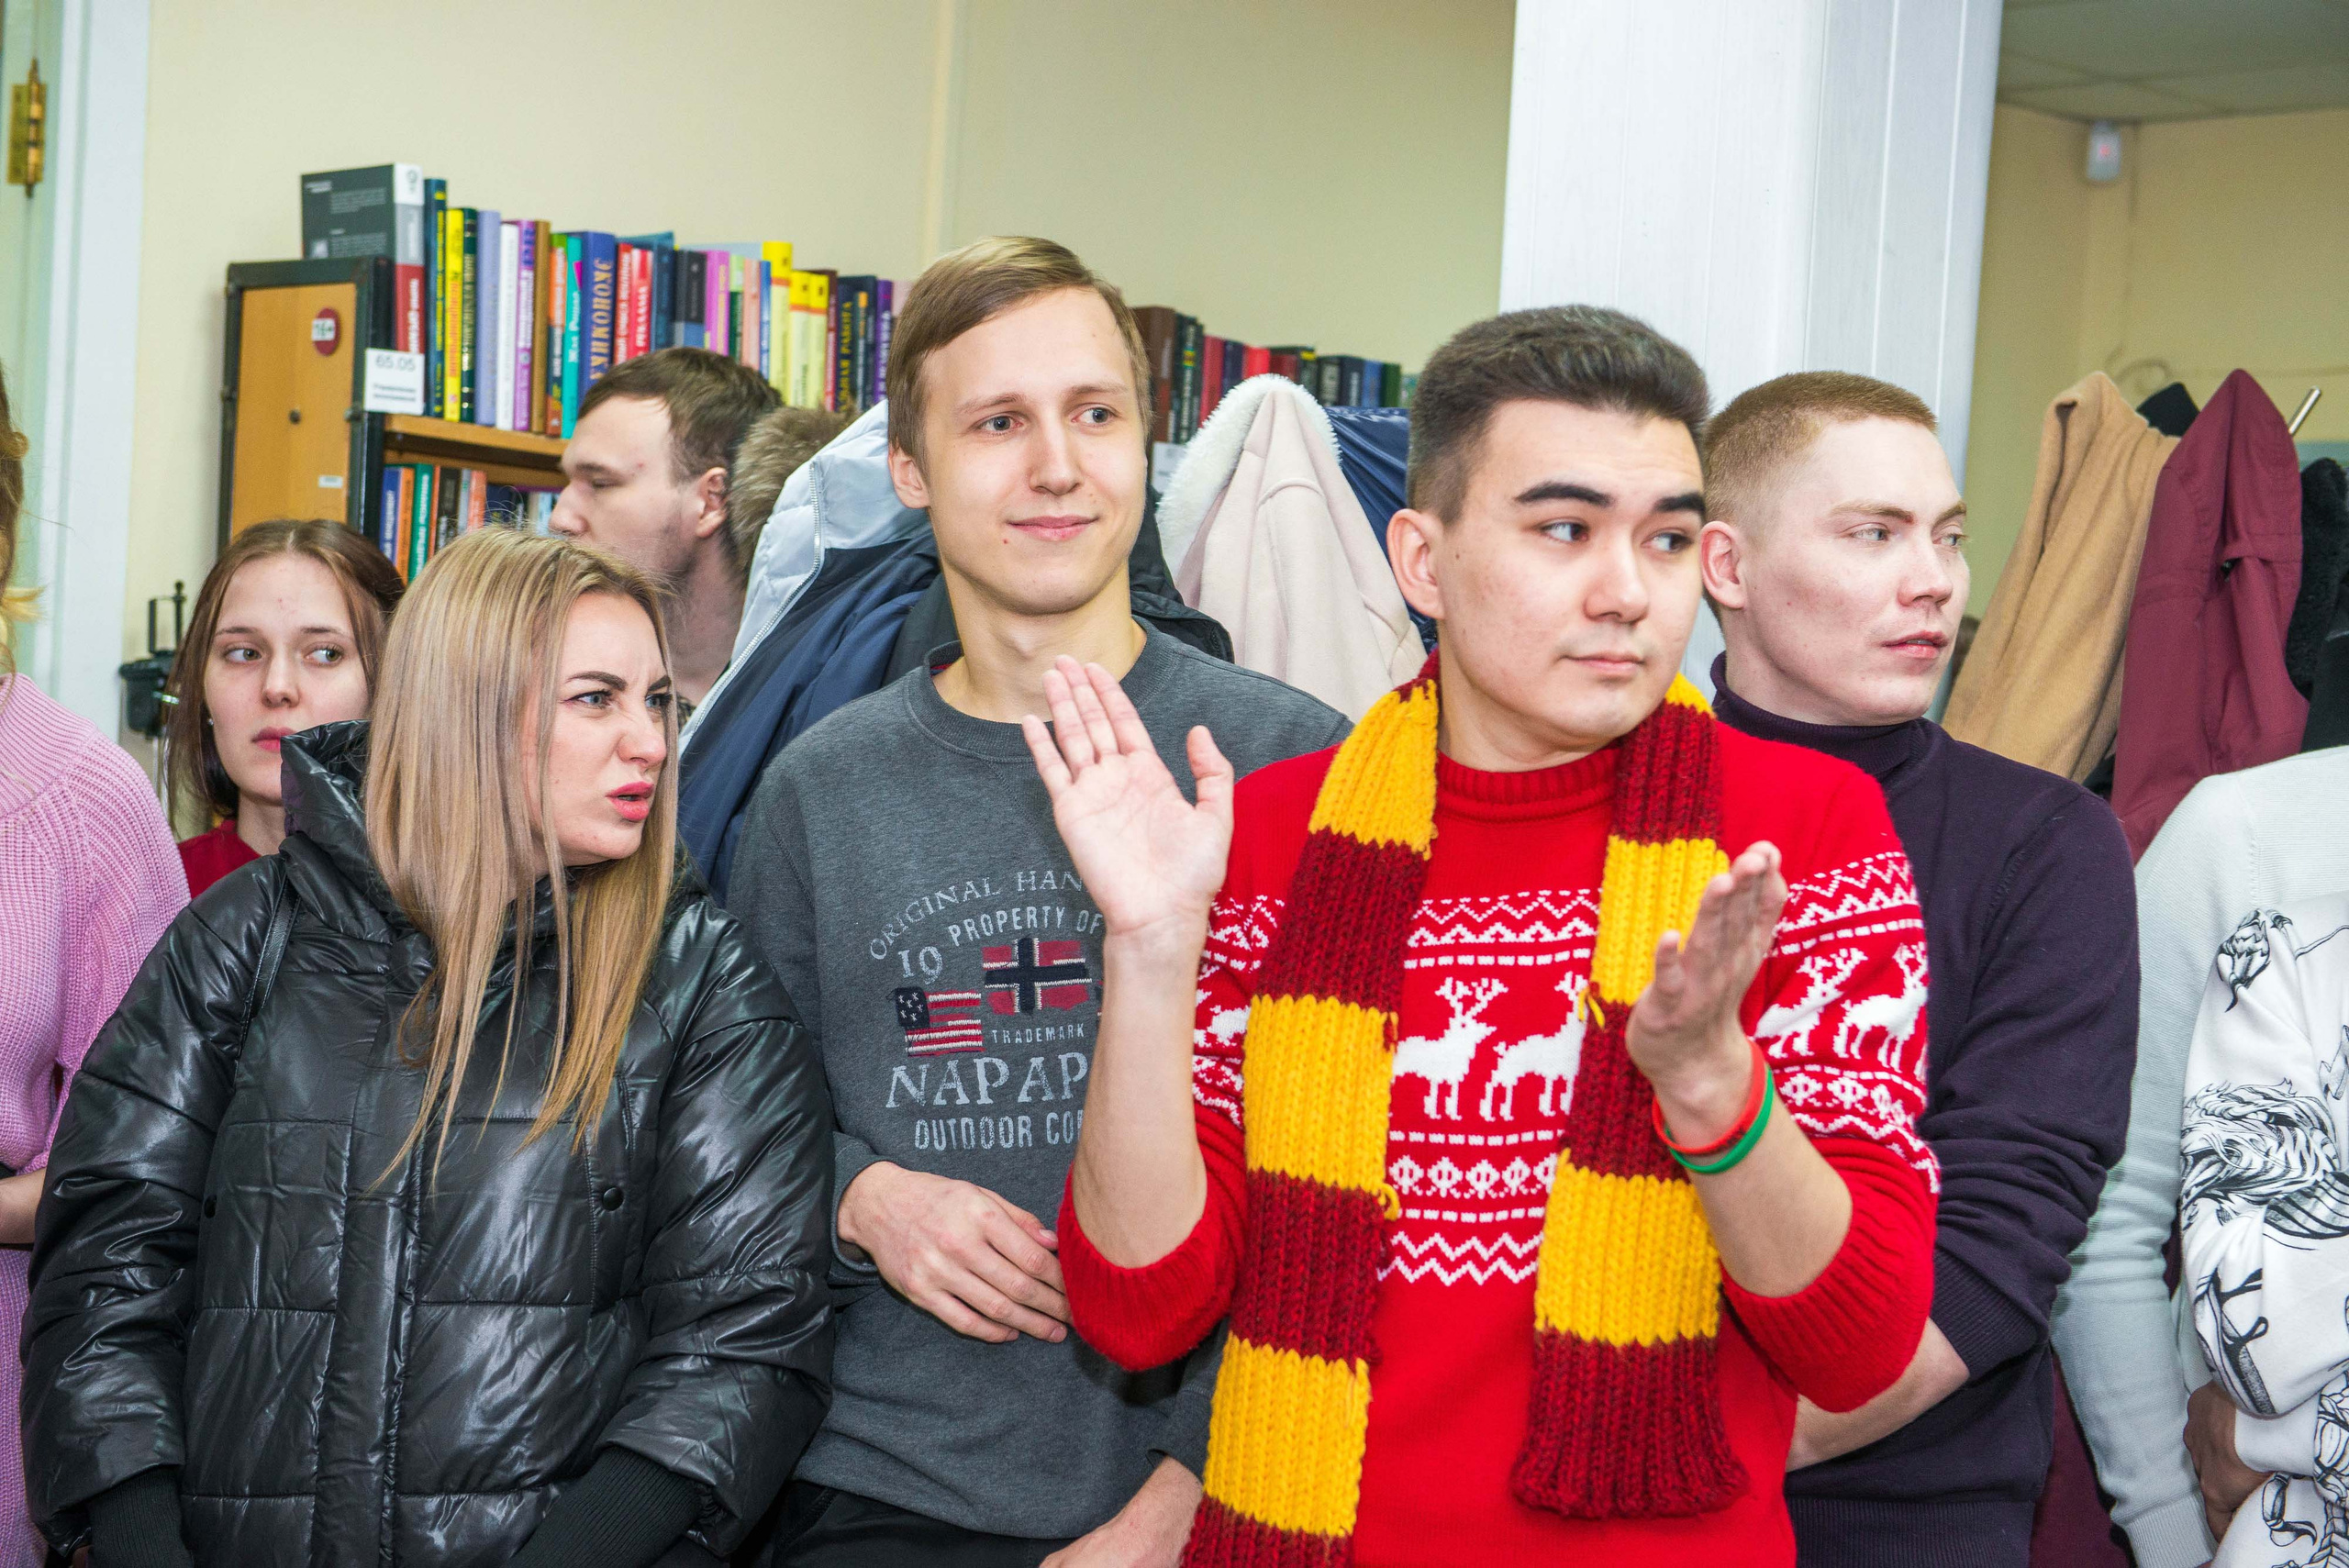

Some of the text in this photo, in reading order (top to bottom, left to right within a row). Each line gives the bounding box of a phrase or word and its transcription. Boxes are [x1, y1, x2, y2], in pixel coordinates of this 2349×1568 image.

[375, 354, 416, 373] 65.05
[869, 876, 1002, 961] ORIGINAL
[948, 905, 1104, 948] PROPERTY OF
[992, 1023, 1085, 1045] TRADEMARK
[914, 1114, 1034, 1151] OUTDOOR
